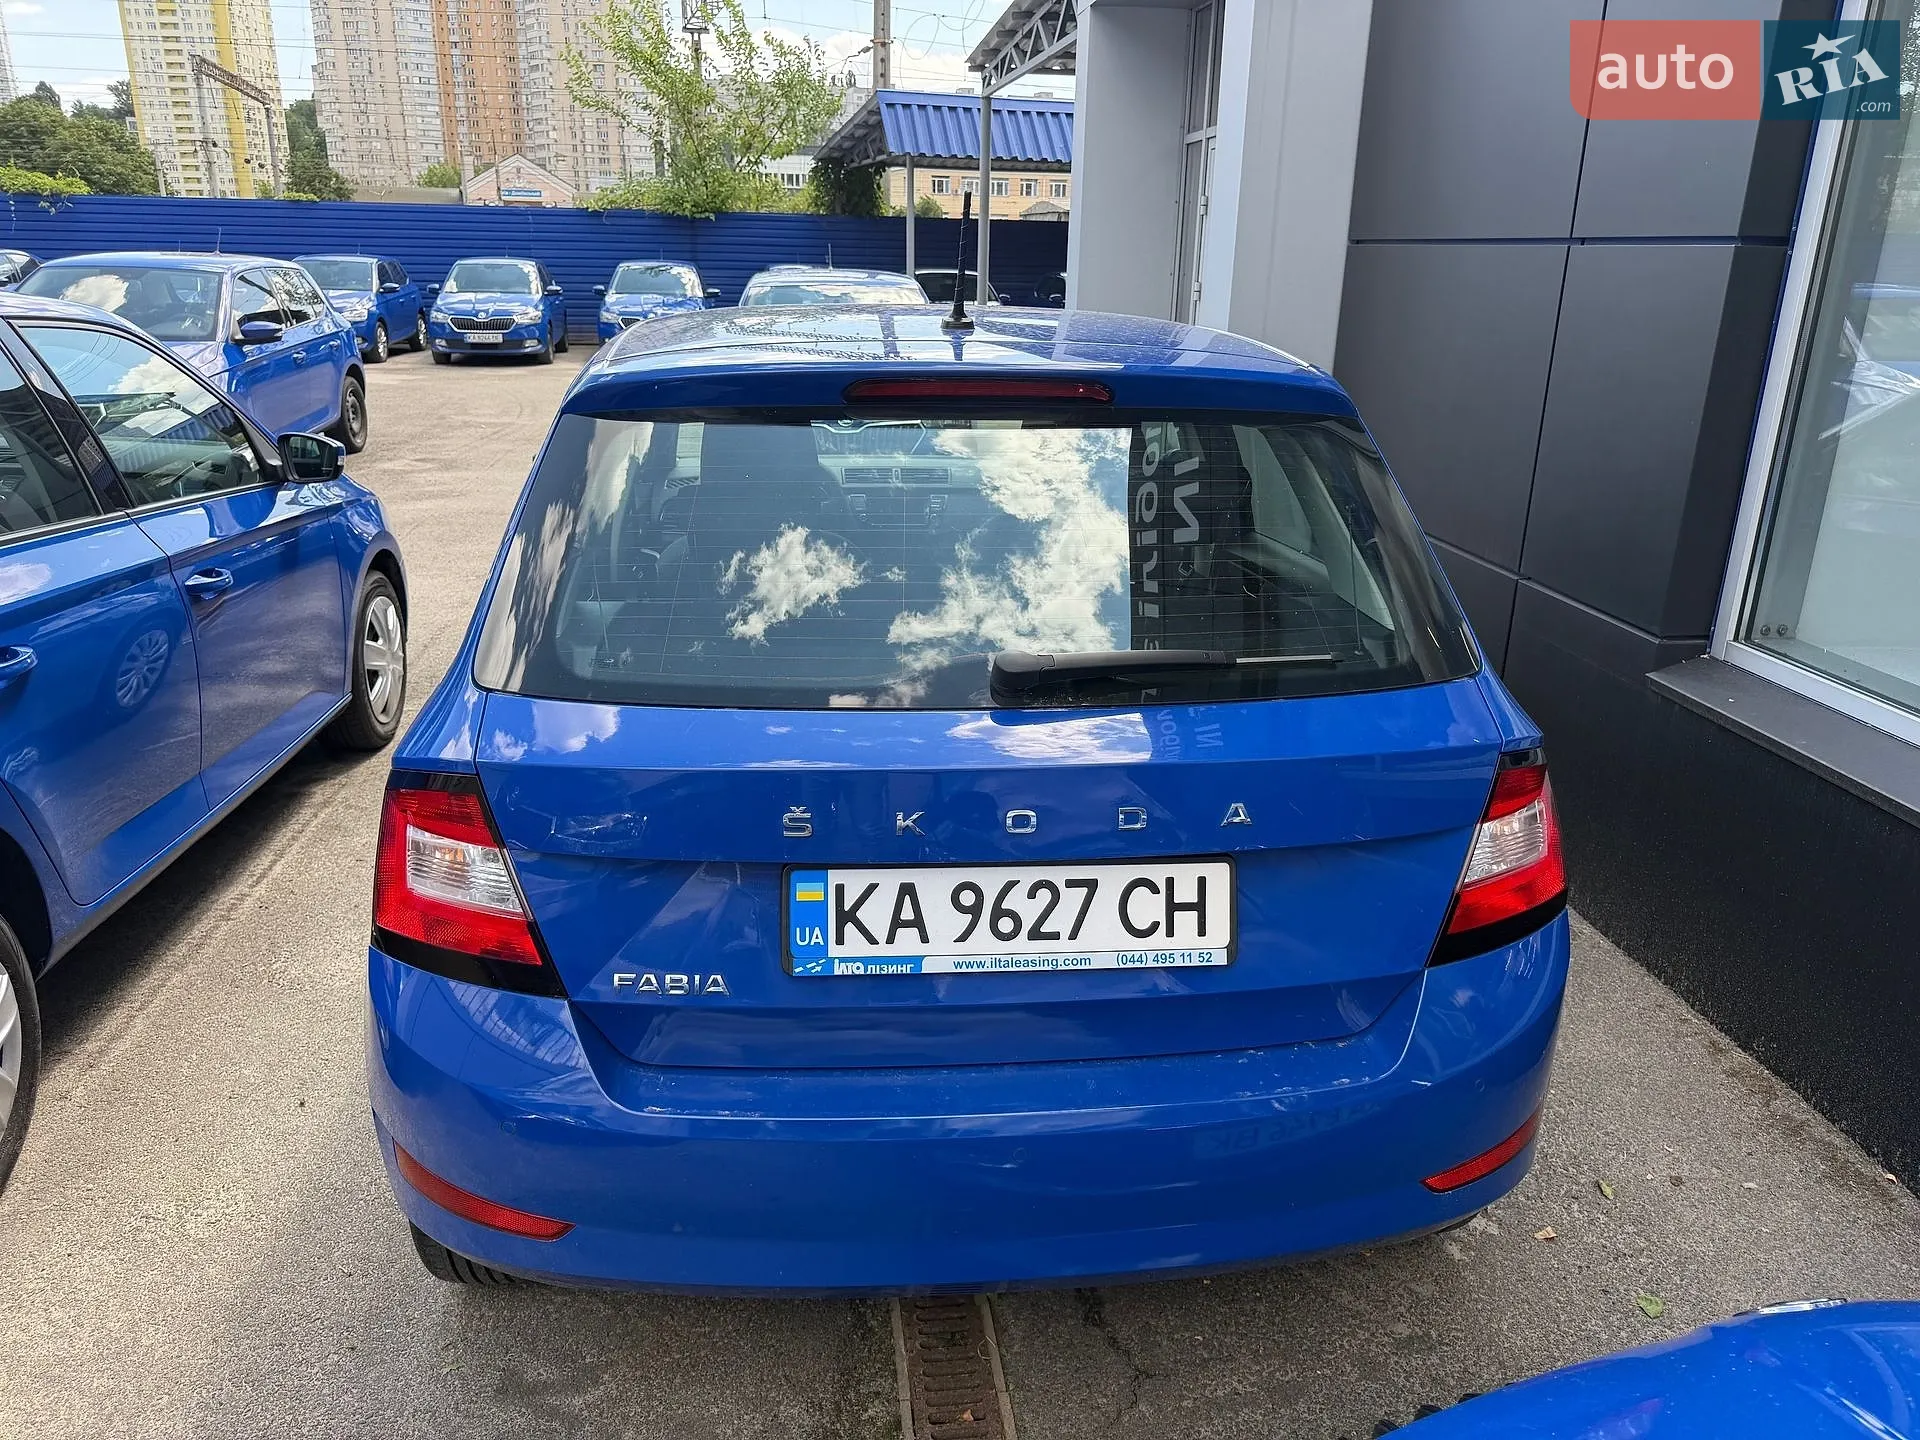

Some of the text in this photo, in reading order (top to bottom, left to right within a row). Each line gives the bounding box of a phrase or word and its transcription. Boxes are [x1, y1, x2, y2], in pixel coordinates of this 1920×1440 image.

[783, 802, 1253, 838] ŠKODA
[833, 875, 1207, 946] KA 9627 CH
[796, 926, 824, 946] UA
[953, 956, 1092, 969] www.iltaleasing.com
[1116, 951, 1213, 966] (044) 495 11 52
[613, 973, 730, 996] FABIA
